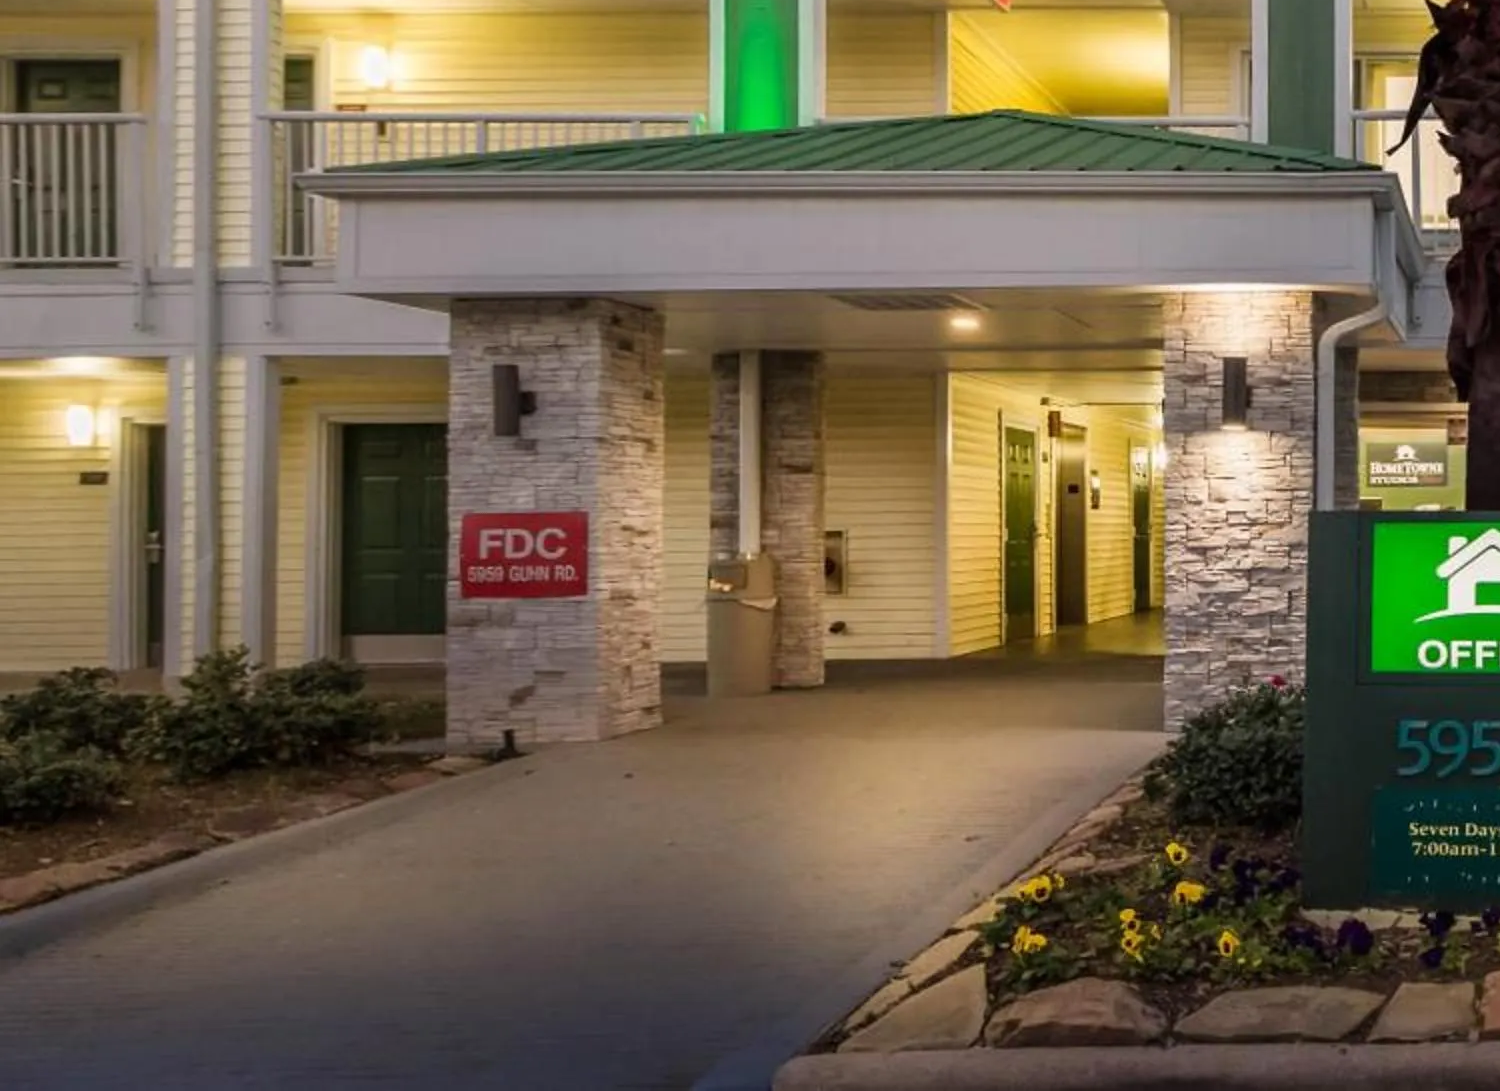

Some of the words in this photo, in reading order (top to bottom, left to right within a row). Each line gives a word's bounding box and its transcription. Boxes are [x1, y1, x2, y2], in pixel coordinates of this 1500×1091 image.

[479, 527, 569, 560] FDC
[467, 565, 504, 583] 5959
[554, 564, 578, 582] RD.
[1409, 822, 1459, 837] Seven
